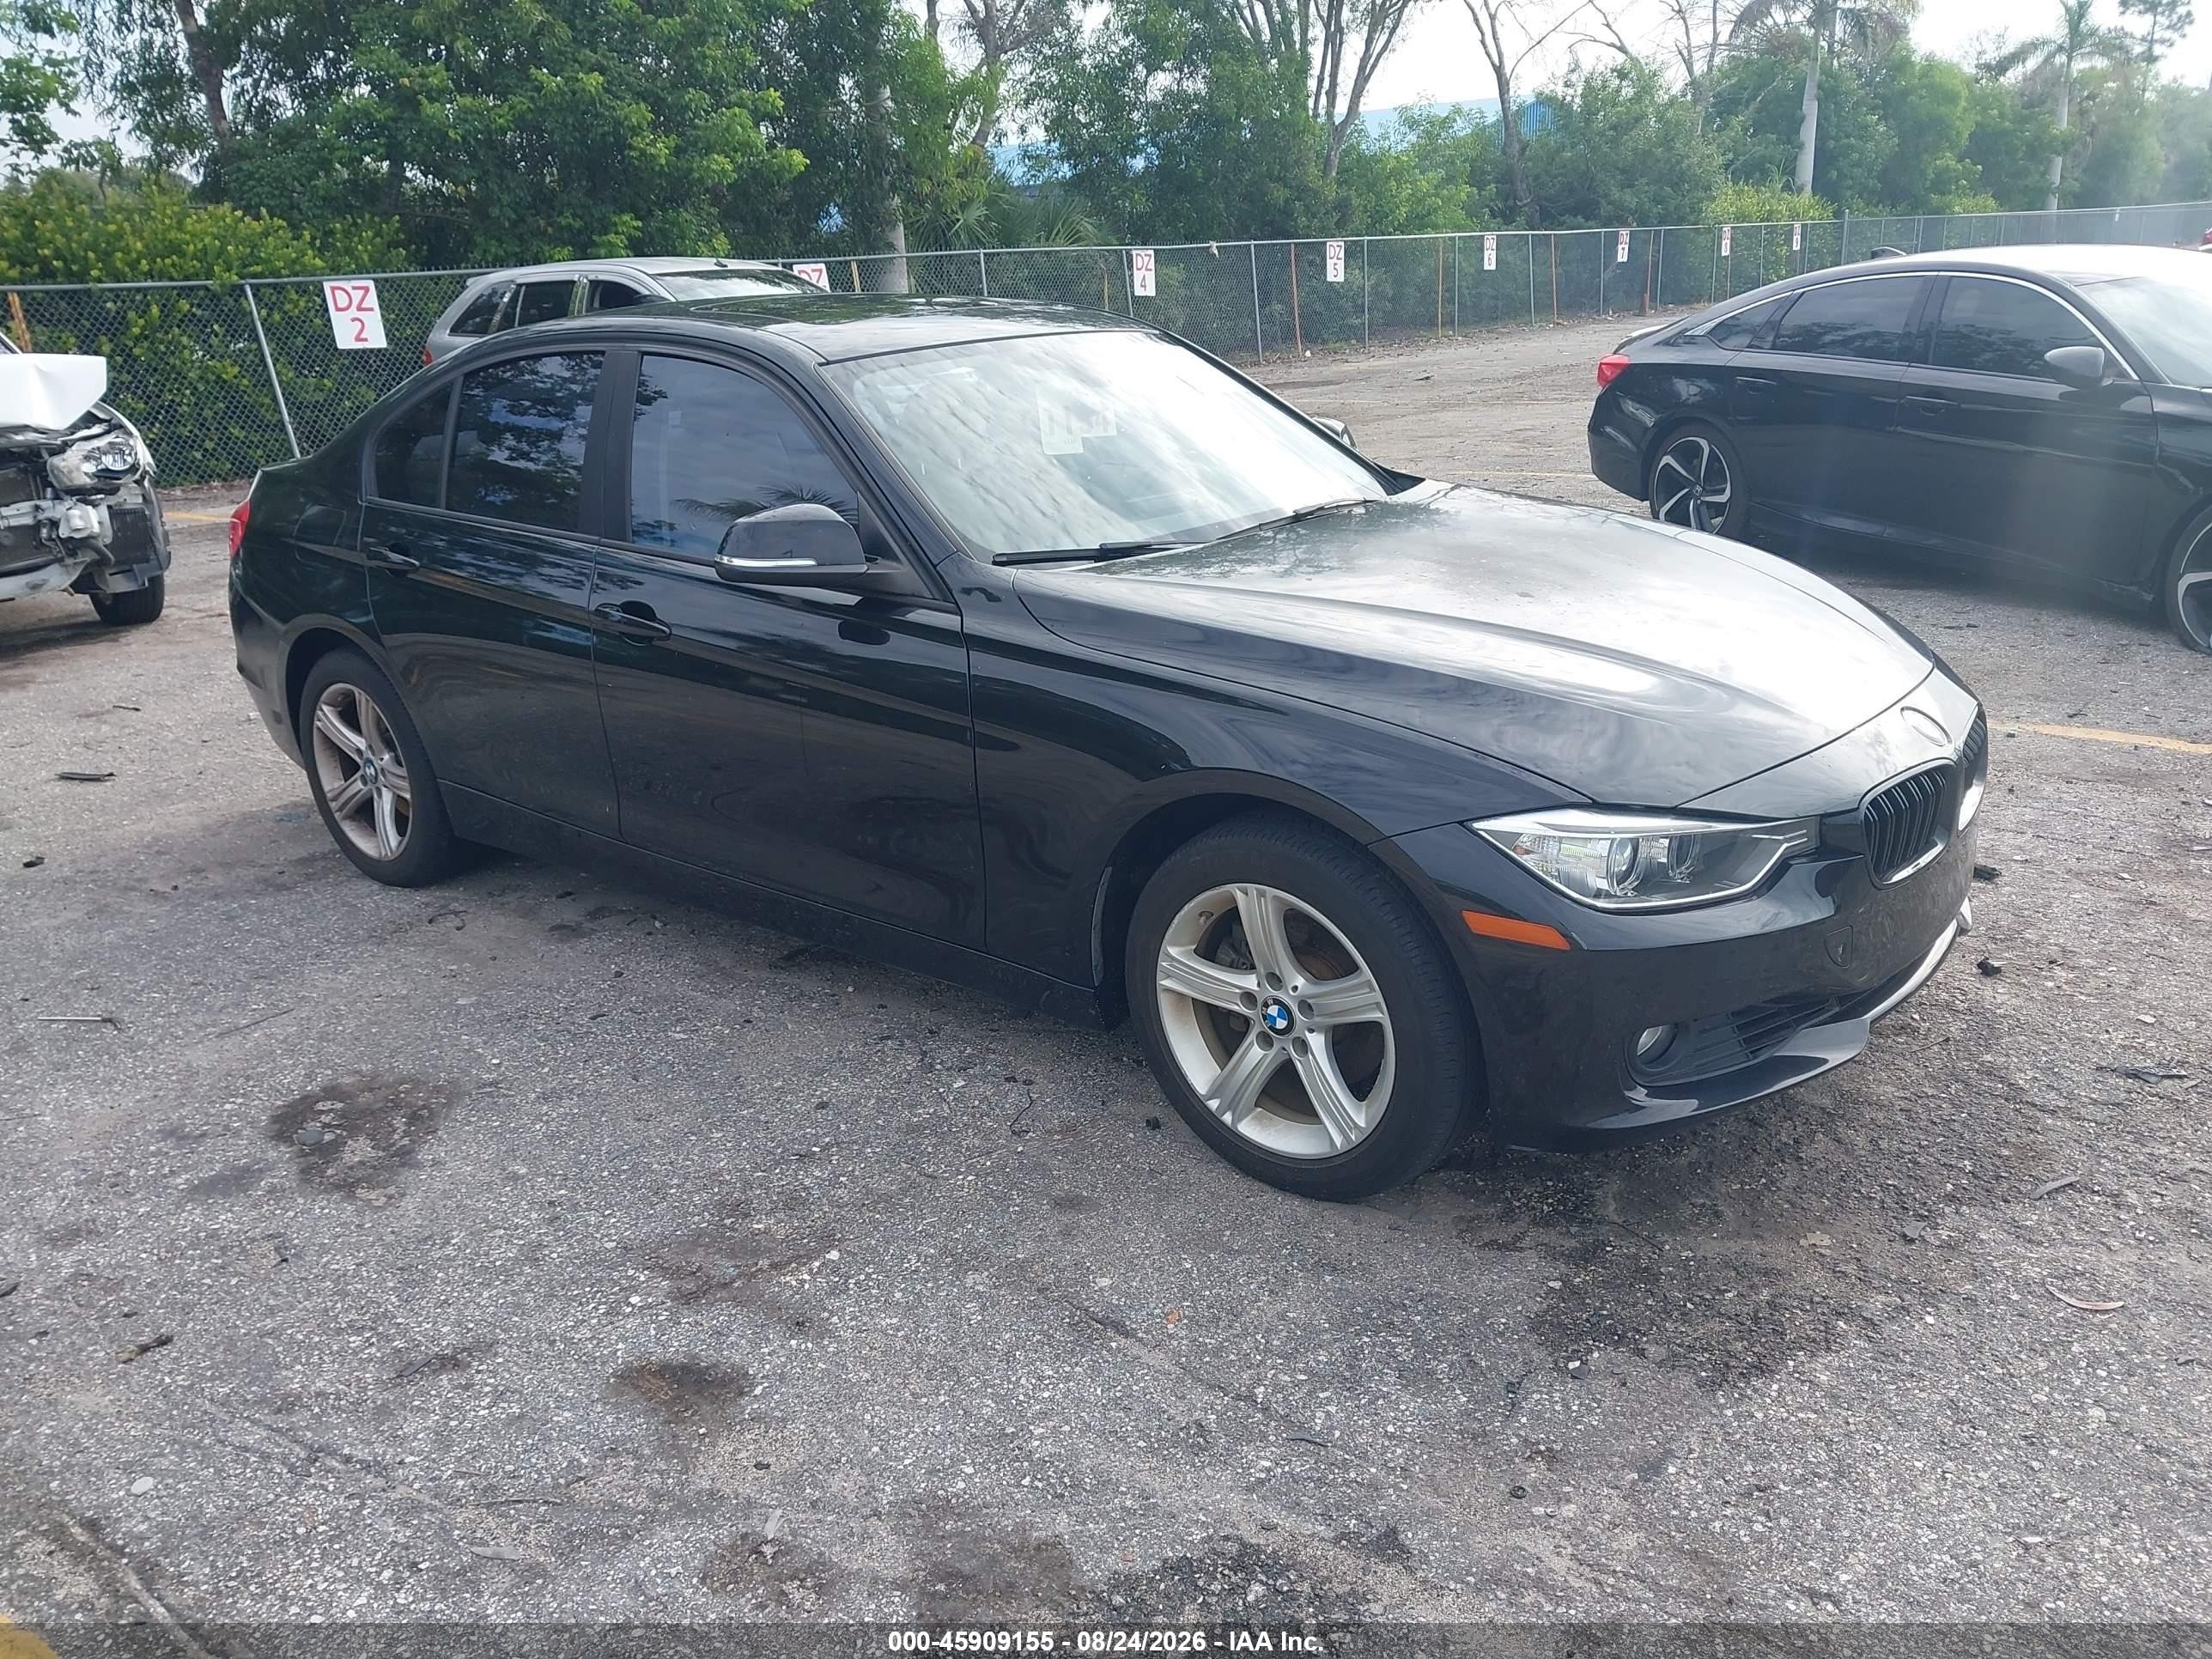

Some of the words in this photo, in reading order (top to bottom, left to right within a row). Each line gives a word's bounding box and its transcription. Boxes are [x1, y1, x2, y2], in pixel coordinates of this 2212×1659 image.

[1620, 232, 1629, 245] DZ
[1723, 228, 1730, 241] DZ
[1486, 237, 1495, 251] DZ
[1328, 244, 1342, 260] DZ
[1487, 252, 1492, 266] 6
[1621, 246, 1626, 259] 7
[1135, 252, 1153, 271] DZ
[1333, 262, 1339, 277] 5
[1139, 274, 1147, 292] 4
[330, 285, 374, 312] DZ
[349, 316, 368, 343] 2
